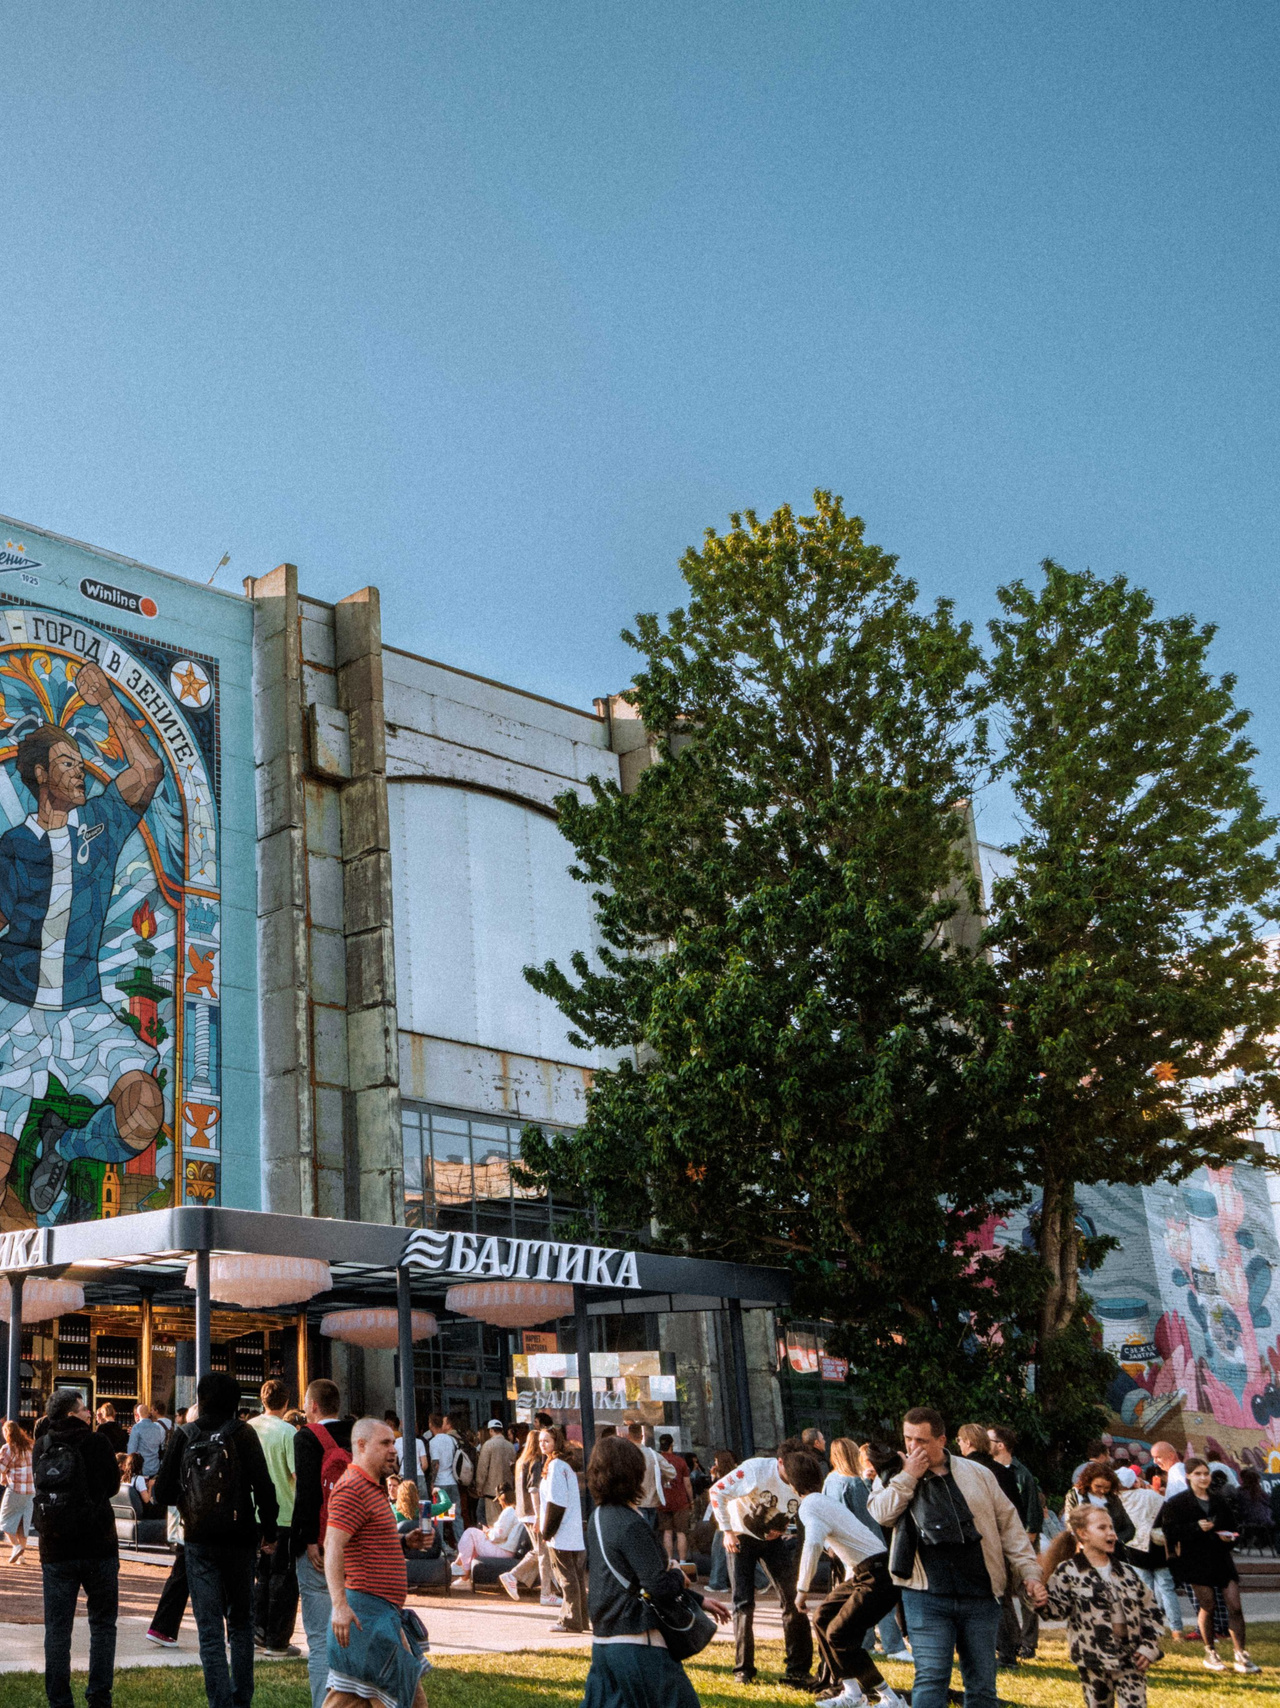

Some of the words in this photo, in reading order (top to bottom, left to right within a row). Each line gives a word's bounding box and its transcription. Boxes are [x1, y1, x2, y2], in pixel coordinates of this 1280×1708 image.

[21, 573, 39, 586] 1925
[85, 580, 136, 609] Winline
[32, 617, 101, 664] ГОРОД
[107, 650, 122, 673] В
[126, 669, 194, 762] ЗЕНИТЕ
[445, 1231, 642, 1289] БАЛТИКА
[1124, 1344, 1157, 1354] СВЕЖЕЕ
